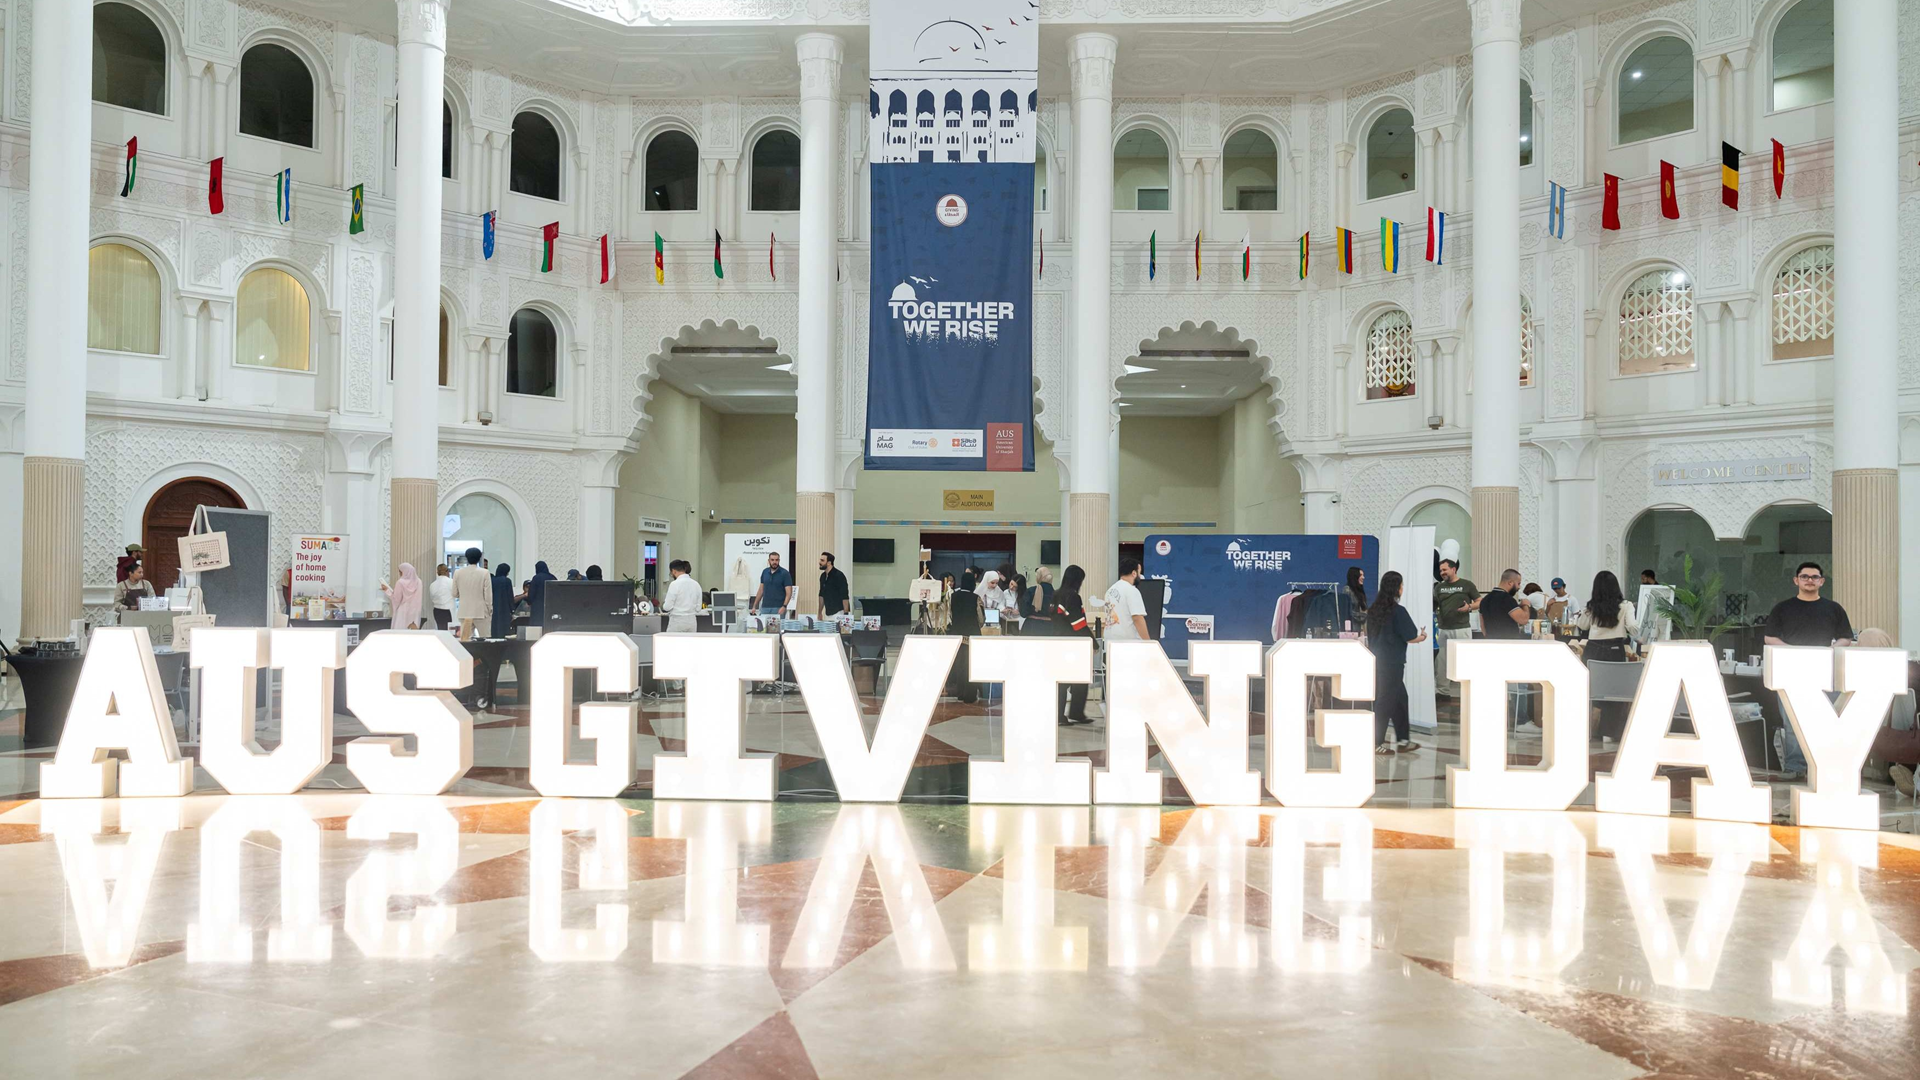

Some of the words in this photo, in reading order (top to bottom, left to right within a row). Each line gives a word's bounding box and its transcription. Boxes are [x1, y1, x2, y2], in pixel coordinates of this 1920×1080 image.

[888, 302, 1014, 319] TOGETHER
[903, 320, 940, 338] WE
[945, 320, 999, 339] RISE
[996, 430, 1014, 438] AUS
[1658, 466, 1734, 480] WELCOME
[1743, 463, 1807, 477] CENTER
[301, 540, 332, 550] SUMAC
[744, 536, 770, 547] تكوين
[296, 552, 309, 560] The
[310, 553, 322, 562] joy
[1226, 551, 1291, 560] TOGETHER
[296, 563, 304, 571] of
[305, 563, 326, 571] home
[1233, 560, 1253, 570] WE
[1254, 560, 1283, 570] RISE
[295, 574, 325, 583] cooking
[40, 626, 474, 799] AUS
[529, 631, 1376, 808] GIVING
[1446, 639, 1909, 831] DAY
